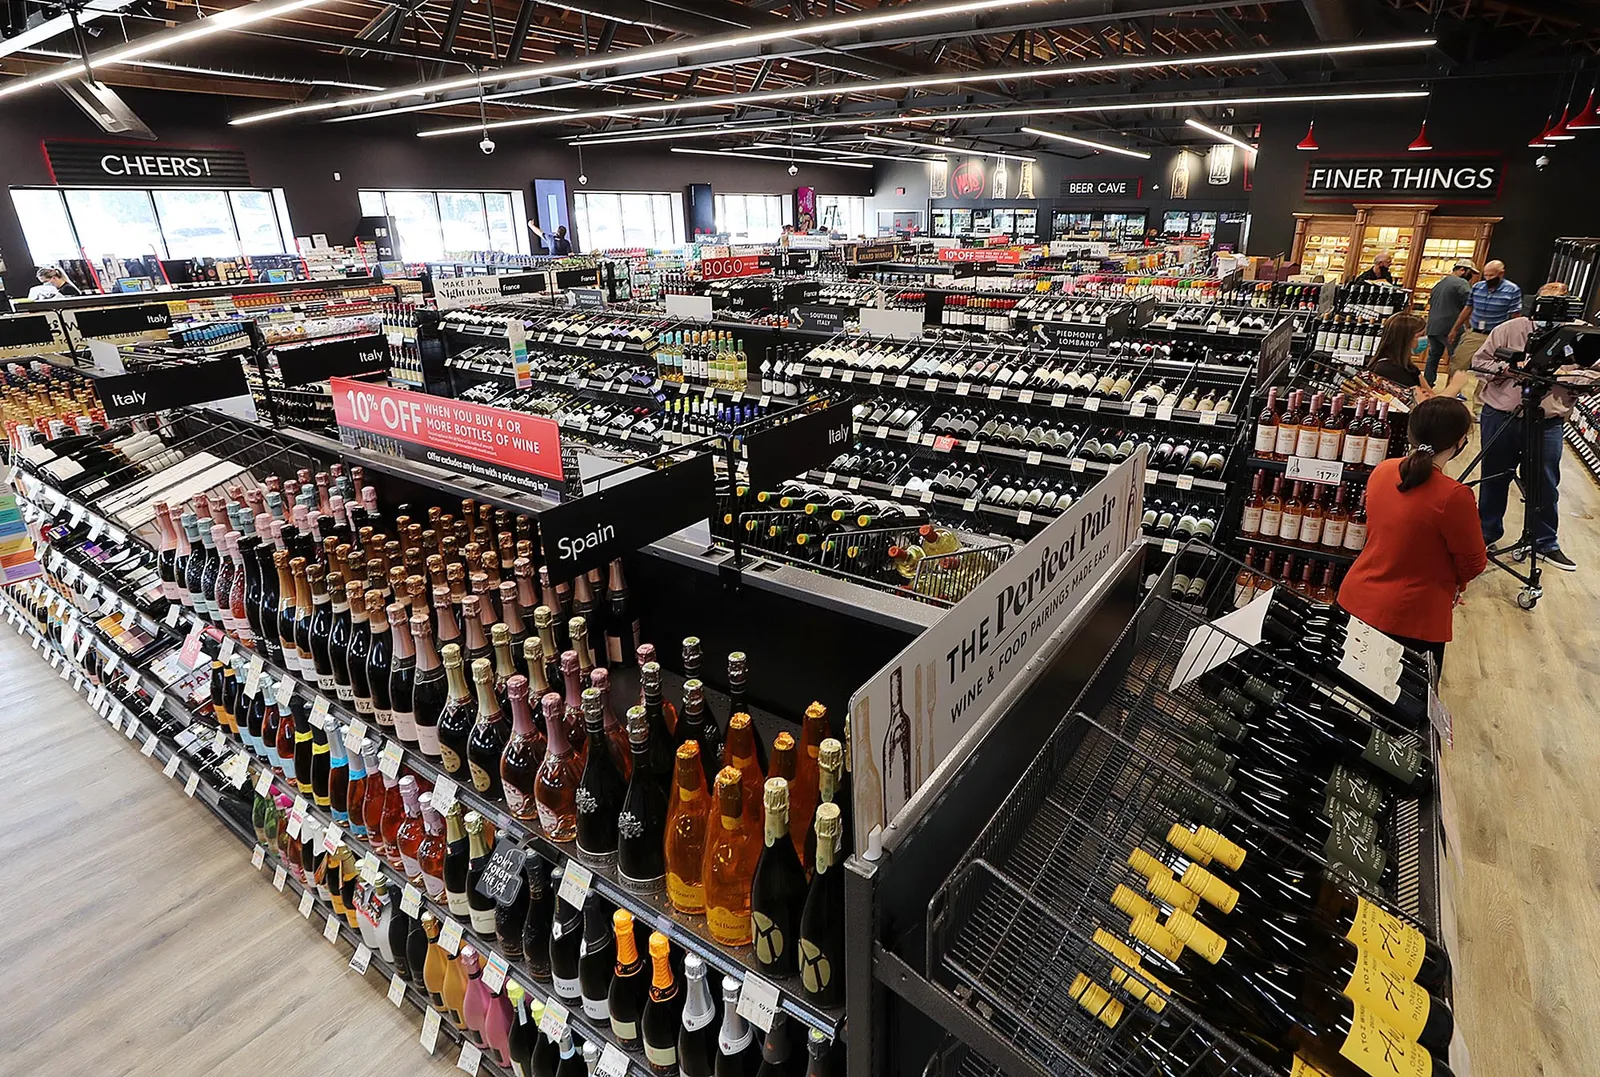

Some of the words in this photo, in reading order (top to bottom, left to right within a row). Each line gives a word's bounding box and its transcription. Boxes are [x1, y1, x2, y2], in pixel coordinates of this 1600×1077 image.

[101, 154, 212, 177] CHEERS!
[1069, 181, 1093, 194] BEER
[1097, 180, 1126, 194] CAVE
[1311, 168, 1382, 189] FINER
[1391, 167, 1494, 189] THINGS
[958, 251, 974, 260] OFF
[704, 259, 743, 276] BOGO
[502, 283, 521, 291] France
[803, 290, 817, 298] France
[147, 314, 168, 324] Italy
[809, 312, 838, 320] SOUTHERN
[1056, 330, 1095, 340] PIEDMONT
[1058, 338, 1100, 347] LOMBARDY
[359, 349, 384, 363] Italy
[111, 389, 147, 407] Italy
[346, 389, 379, 423] 10%
[380, 396, 422, 434] OFF
[424, 403, 451, 418] WHEN
[452, 407, 472, 423] YOU
[475, 413, 494, 428] BUY
[497, 418, 504, 430] 4
[506, 420, 522, 434] OR
[426, 418, 451, 433] MORE
[455, 423, 493, 443] BOTTLES
[495, 434, 509, 447] OF
[512, 436, 540, 454] WINE
[828, 423, 849, 445] Italy
[426, 451, 441, 462] Offer
[441, 456, 463, 468] excludes
[462, 462, 472, 472] any
[485, 467, 498, 478] with
[502, 472, 517, 483] price
[517, 476, 538, 491] ending
[557, 523, 615, 560] Spain
[946, 616, 990, 684] THE
[995, 523, 1077, 638] Perfect
[1080, 493, 1116, 554] Pair
[950, 676, 983, 723] WINE
[987, 665, 995, 685] &
[998, 631, 1027, 673] FOOD
[1030, 587, 1070, 637] PAIRINGS
[1071, 563, 1092, 593] MADE
[1093, 543, 1112, 568] EASY
[492, 852, 514, 870] DON'T
[482, 872, 494, 886] THE
[486, 862, 512, 884] FORGET
[1361, 926, 1368, 937] TO
[1407, 942, 1420, 968] PINOT
[1364, 974, 1370, 985] TO
[1411, 993, 1424, 1022] PINOT
[1361, 1034, 1367, 1045] TO
